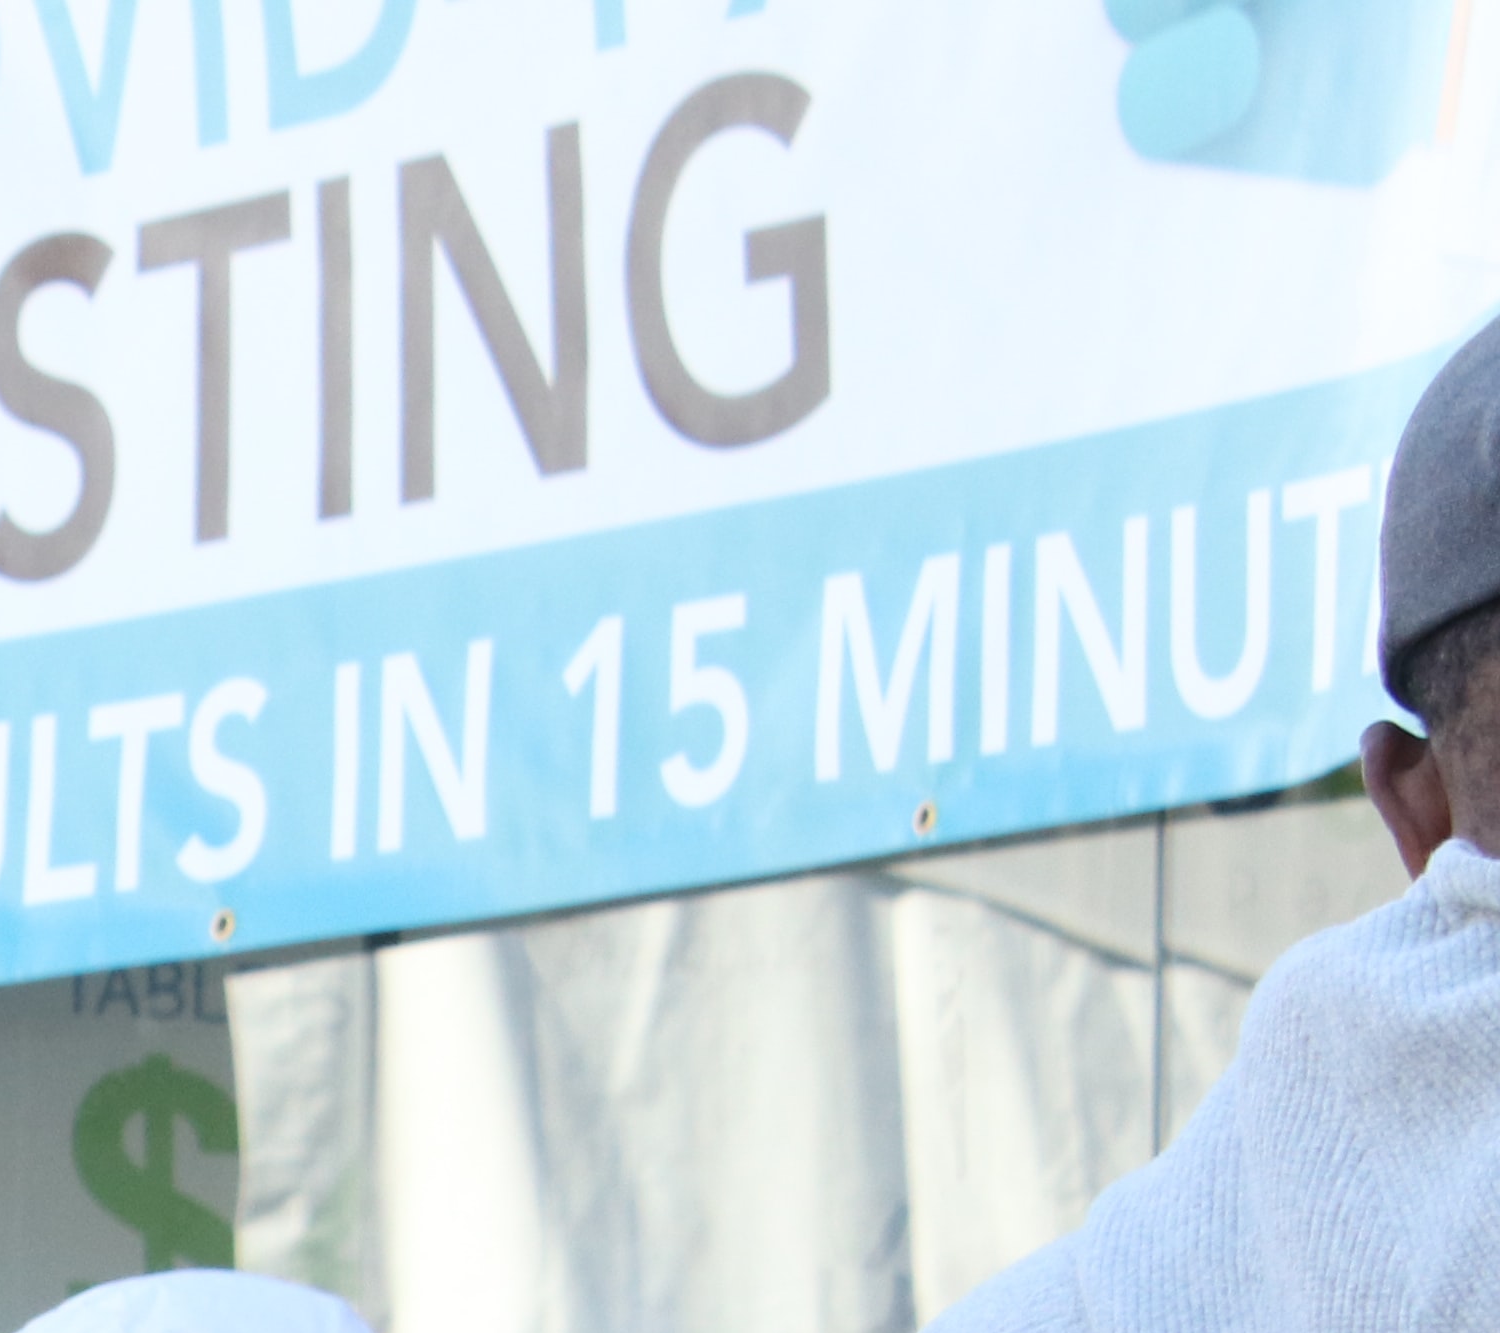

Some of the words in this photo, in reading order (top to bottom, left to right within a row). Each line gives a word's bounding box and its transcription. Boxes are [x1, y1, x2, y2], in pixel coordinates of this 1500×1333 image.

[331, 639, 492, 862] IN
[562, 594, 750, 820] 15
[814, 458, 1385, 783] MINUT
[70, 956, 275, 1024] TABL
